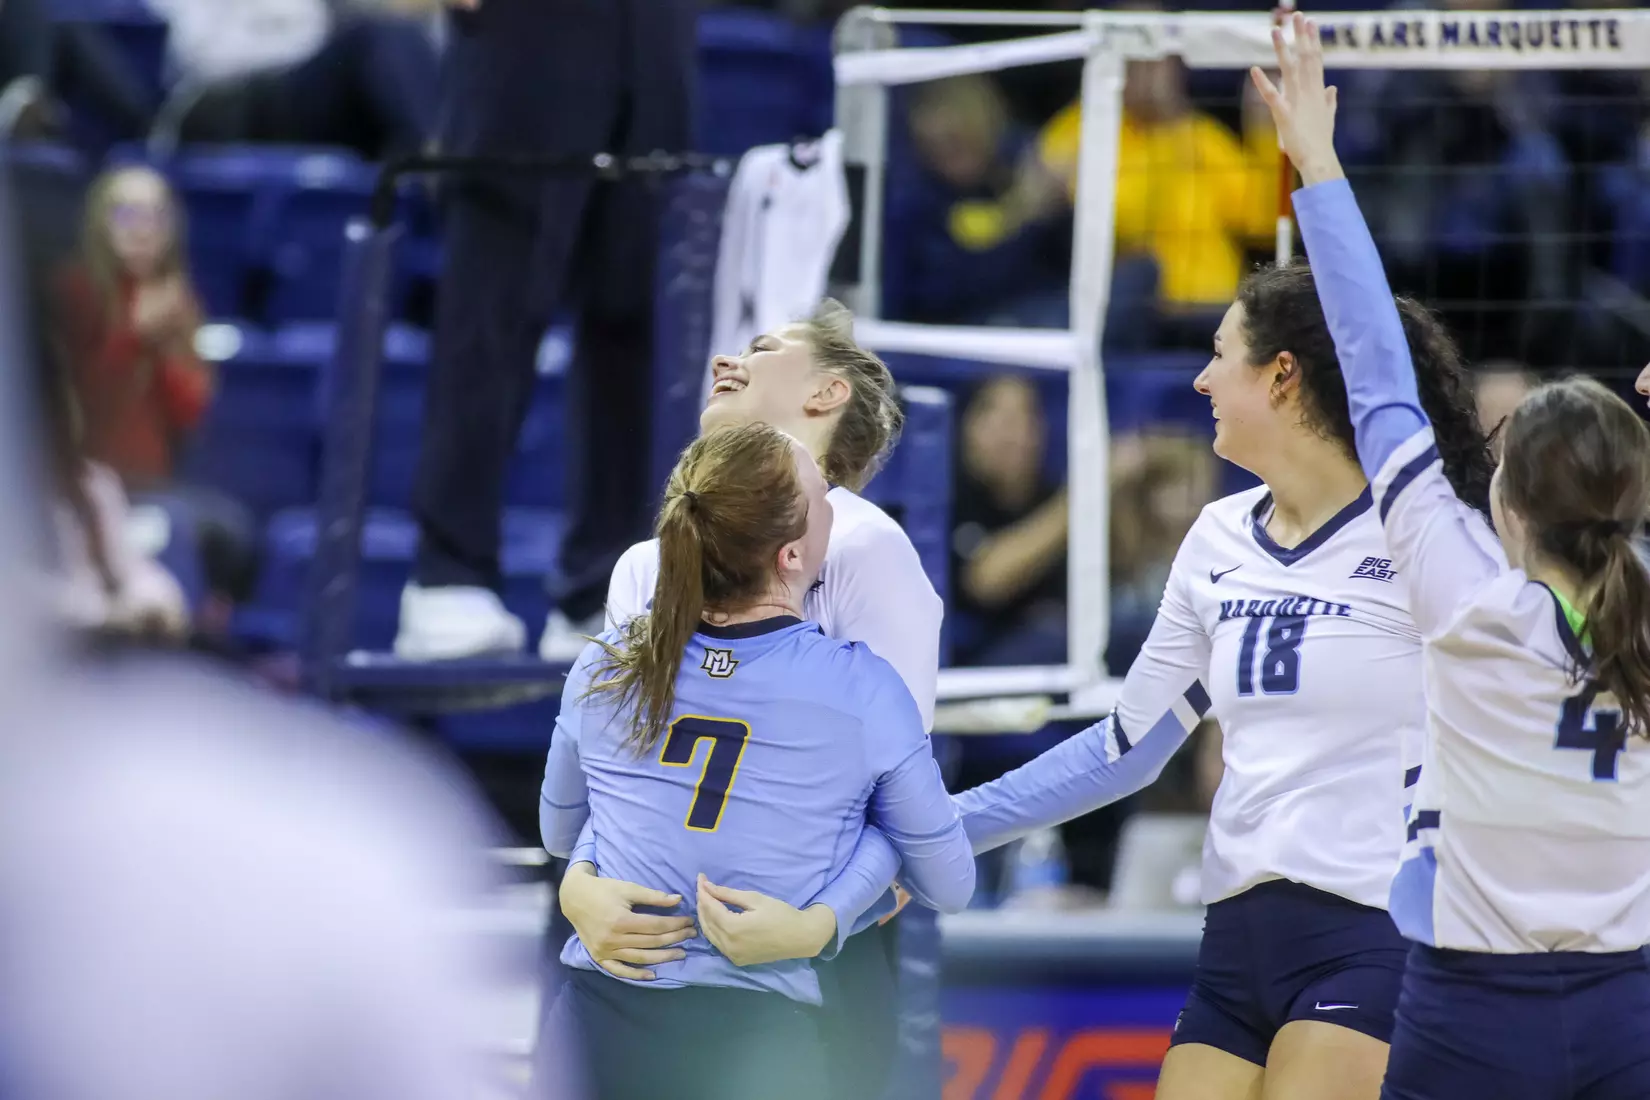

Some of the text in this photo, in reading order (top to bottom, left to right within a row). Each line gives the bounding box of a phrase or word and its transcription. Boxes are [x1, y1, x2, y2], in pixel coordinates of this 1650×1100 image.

[1369, 20, 1426, 48] ARE
[1440, 18, 1621, 52] MARQUETTE
[1353, 565, 1398, 580] EAST
[1360, 556, 1392, 569] BIG
[700, 647, 740, 679] MU
[1236, 616, 1308, 697] 18
[1553, 676, 1628, 783] 4
[658, 713, 752, 833] 7
